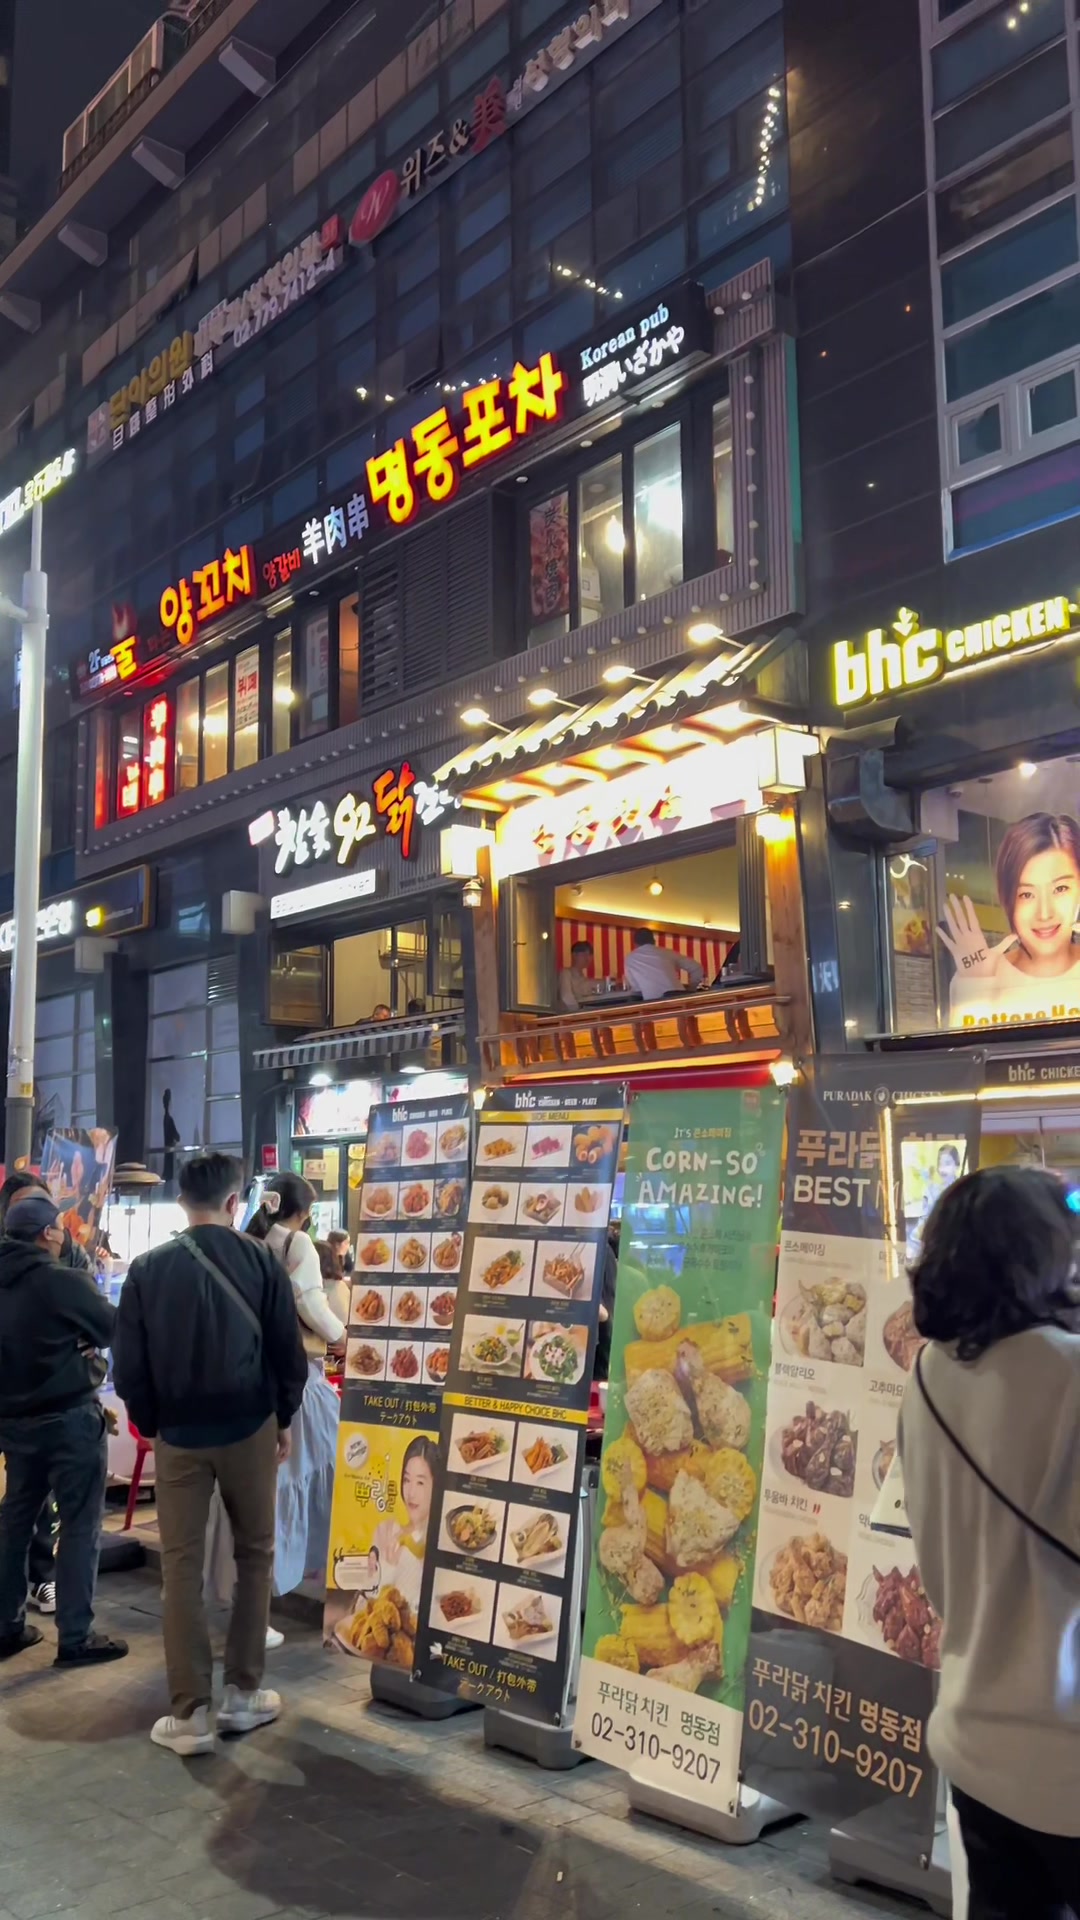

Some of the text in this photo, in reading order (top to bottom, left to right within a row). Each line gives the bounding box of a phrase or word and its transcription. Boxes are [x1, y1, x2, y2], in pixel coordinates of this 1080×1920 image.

[580, 303, 670, 370] Korean pub
[366, 352, 563, 523] 명동포차
[302, 492, 370, 564] 羊肉串
[159, 544, 252, 645] 양꼬치
[262, 548, 300, 588] 양갈비
[834, 596, 1070, 706] bhc CHICKEN
[962, 949, 988, 969] BHC
[1008, 1062, 1036, 1081] bhc
[515, 1090, 536, 1108] bhc
[823, 1090, 872, 1102] PURADAK
[548, 1112, 569, 1122] MENU
[646, 1147, 758, 1176] CORN-SO
[638, 1180, 763, 1208] AMAZING!
[794, 1174, 871, 1208] BEST
[364, 1395, 384, 1409] TAKE
[384, 1398, 399, 1409] OUT
[464, 1396, 491, 1408] BETTER
[499, 1402, 523, 1414] HAPPY
[524, 1407, 551, 1418] CHOICE
[552, 1411, 566, 1420] BHC
[442, 1653, 466, 1671] TAKE
[467, 1661, 488, 1678] OUT
[597, 1681, 721, 1746] 푸라닭 치킨 명동점
[752, 1657, 923, 1752] 푸라닭 치킨 명동점
[591, 1712, 721, 1784] 02-310-9207
[749, 1699, 923, 1798] 02-310-9207
